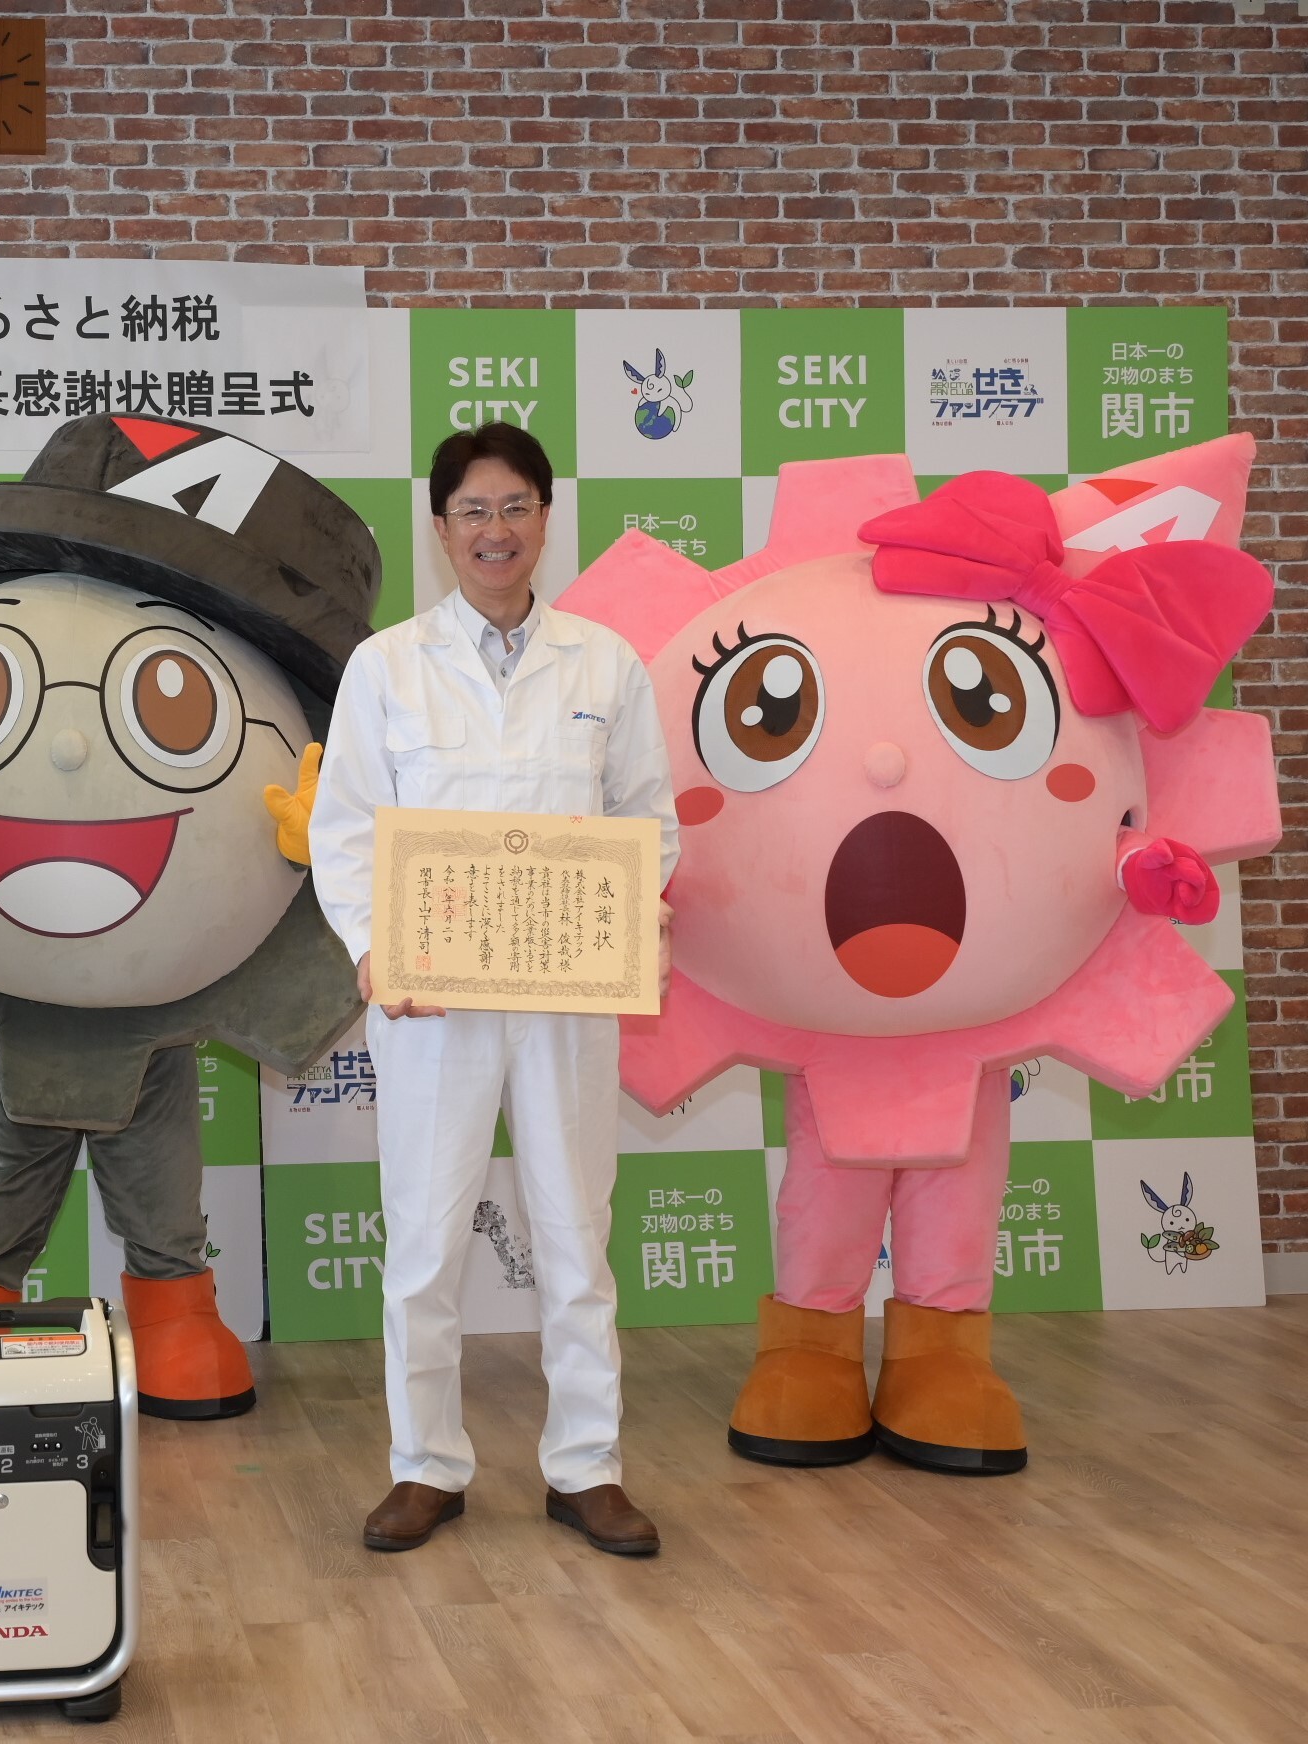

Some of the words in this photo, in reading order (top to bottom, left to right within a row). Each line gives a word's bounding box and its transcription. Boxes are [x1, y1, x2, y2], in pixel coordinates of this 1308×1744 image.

[1112, 342, 1184, 361] 日本一の
[448, 356, 538, 387] SEKI
[777, 354, 867, 386] SEKI
[973, 367, 1025, 396] せき
[1102, 366, 1194, 386] 刃物のまち
[449, 400, 539, 431] CITY
[778, 397, 867, 429] CITY
[930, 398, 1044, 419] ファンクラブ
[1101, 391, 1195, 439] 関市
[623, 513, 698, 533] 日本一の
[593, 876, 615, 951] 感謝状
[286, 1082, 377, 1105] ファンクラ
[649, 1188, 723, 1209] 日本一の
[304, 1211, 385, 1245] SEK
[641, 1212, 734, 1234] 刃物のまち
[641, 1238, 737, 1291] 関市
[0, 1458, 13, 1473] 2
[76, 1454, 89, 1469] 3
[4, 1602, 45, 1613] アイキテック
